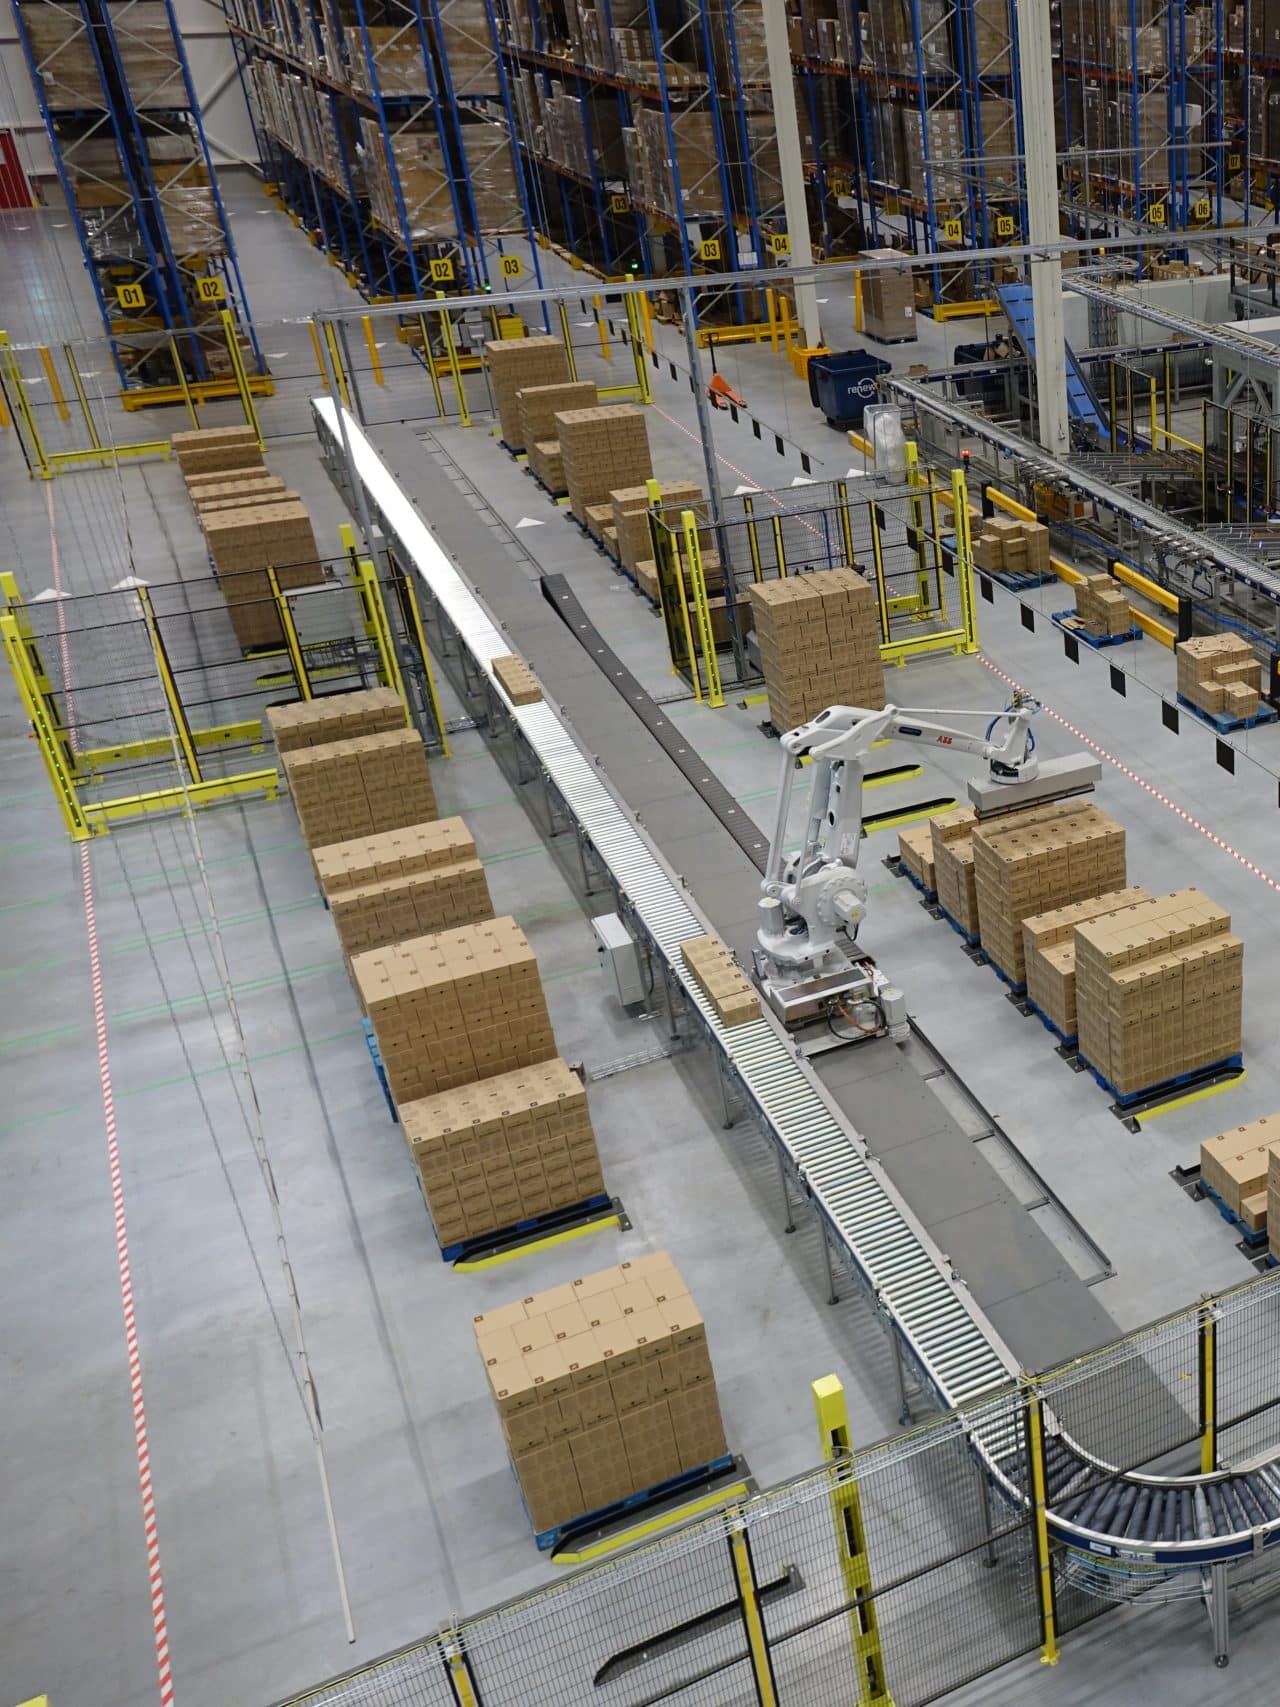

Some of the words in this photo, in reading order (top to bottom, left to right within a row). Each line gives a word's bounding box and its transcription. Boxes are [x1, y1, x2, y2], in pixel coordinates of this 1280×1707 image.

[1151, 207, 1162, 219] 05
[1198, 204, 1208, 216] 06
[948, 223, 959, 237] 04
[1000, 219, 1011, 233] 05
[703, 243, 717, 257] 03
[774, 238, 788, 251] 04
[434, 262, 450, 278] 02
[504, 259, 519, 274] 03
[122, 288, 140, 304] 01
[202, 281, 220, 297] 02
[936, 735, 953, 745] ABB
